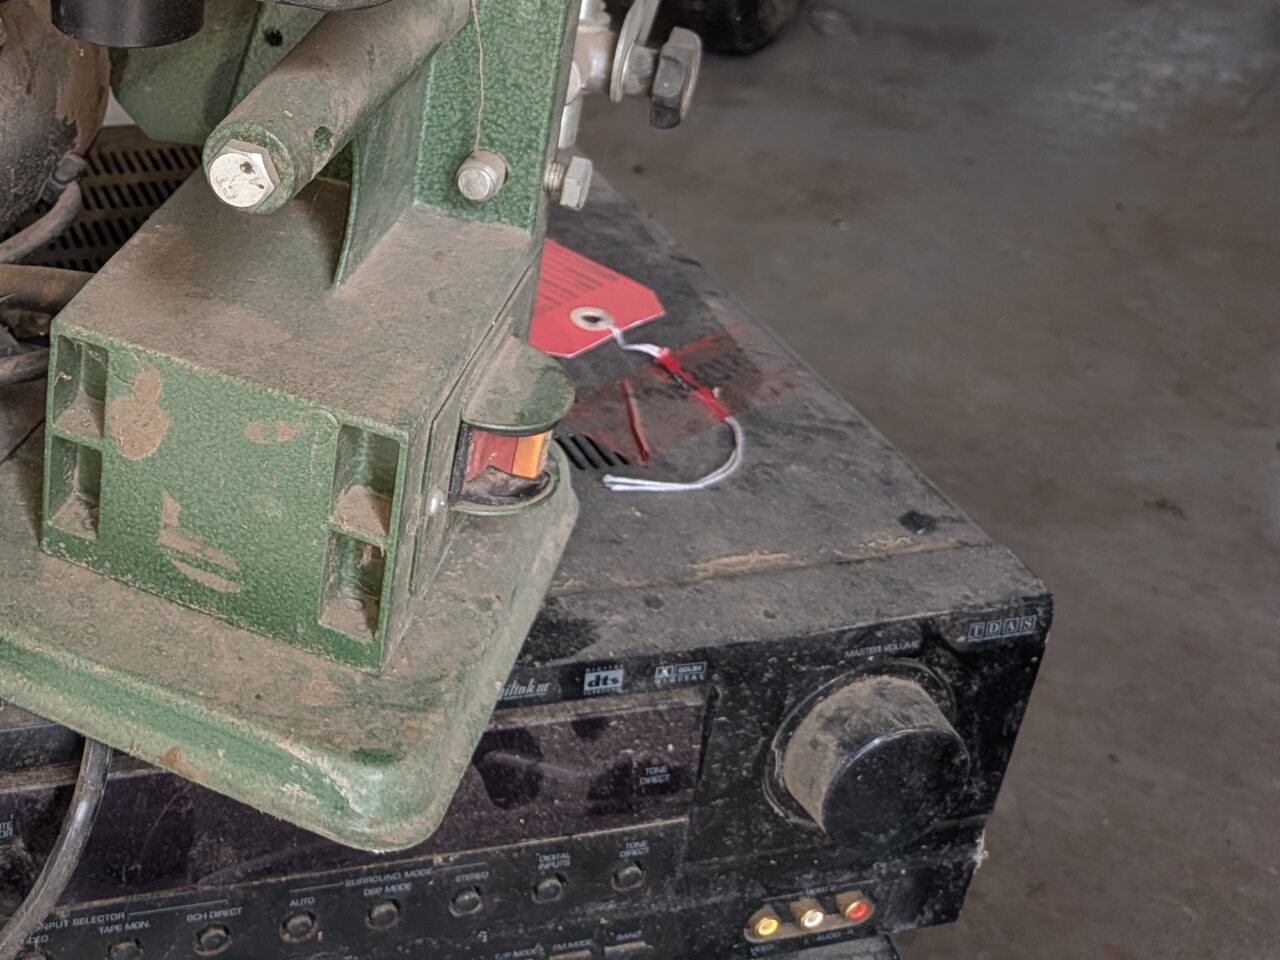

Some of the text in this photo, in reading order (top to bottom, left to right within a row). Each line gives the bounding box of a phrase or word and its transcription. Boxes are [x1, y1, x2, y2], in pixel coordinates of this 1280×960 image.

[586, 672, 621, 689] dts
[645, 765, 669, 776] TONE
[639, 774, 670, 787] DIRECT
[625, 839, 649, 850] TONE
[538, 852, 570, 863] DIGITAL
[619, 846, 650, 858] DIRECT
[538, 859, 571, 870] INPUTS
[345, 867, 433, 887] SURROUND MODE
[455, 871, 489, 883] STEREO
[384, 882, 413, 895] MODE
[289, 896, 316, 907] AUTO
[72, 911, 126, 926] SELECTOR
[209, 906, 243, 920] DIRECT
[98, 924, 122, 935] TAPE
